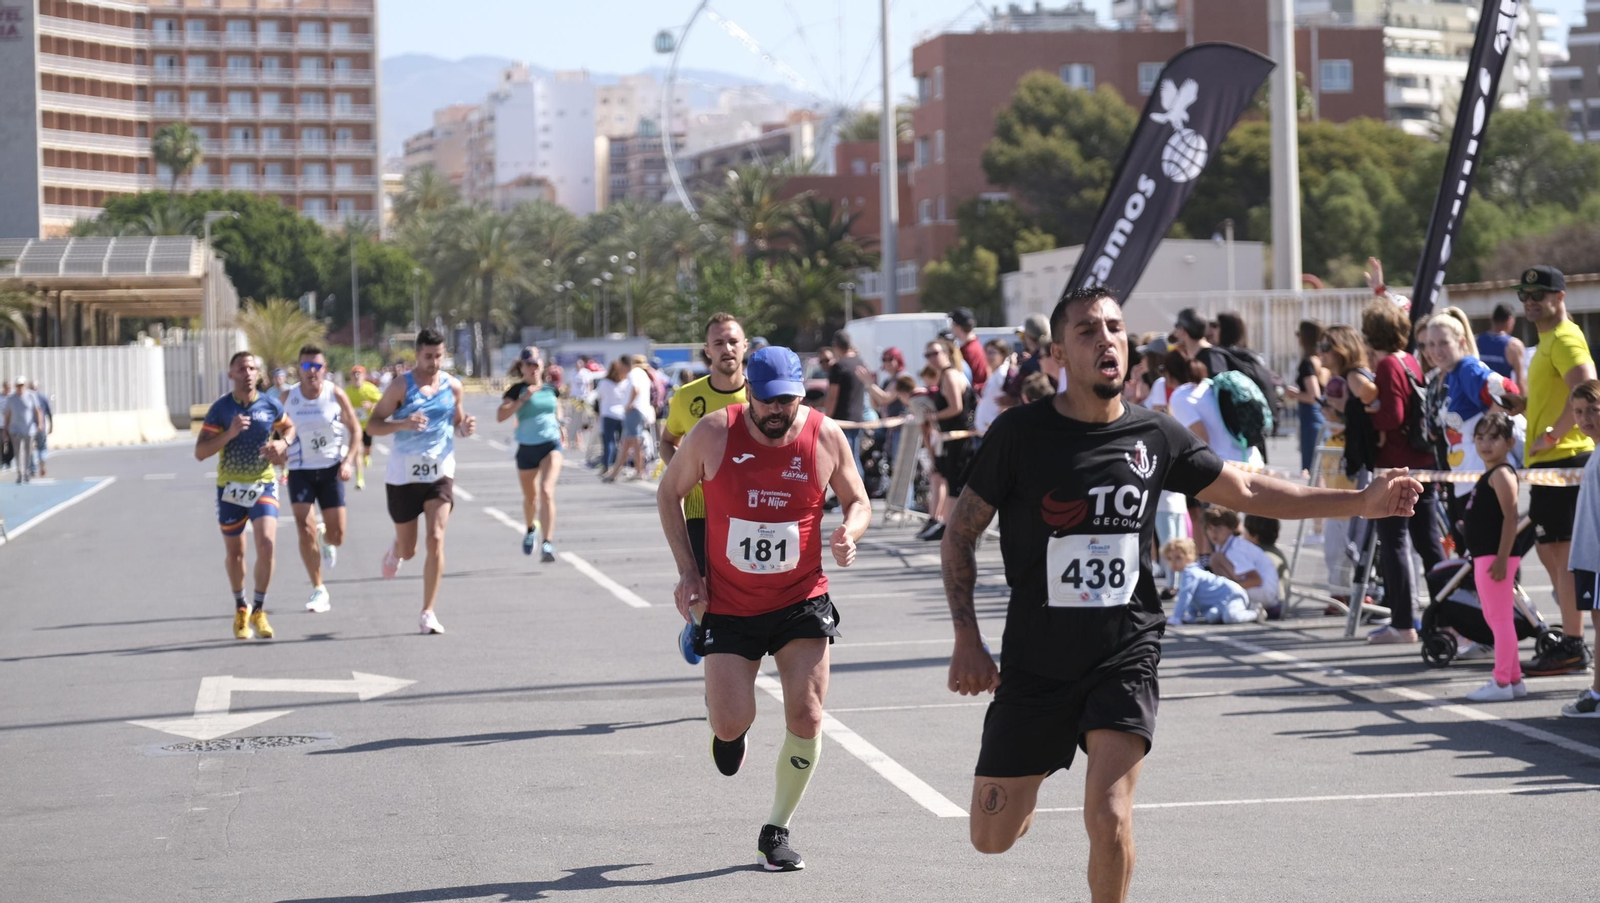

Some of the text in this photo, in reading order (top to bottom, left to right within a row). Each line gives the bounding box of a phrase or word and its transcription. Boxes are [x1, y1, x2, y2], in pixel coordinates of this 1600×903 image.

[310, 436, 327, 450] 36
[412, 463, 438, 476] 291
[230, 488, 257, 499] 179
[760, 489, 791, 498] Ayuntamiento
[1088, 484, 1149, 519] TCI
[739, 537, 787, 562] 181
[1061, 557, 1125, 589] 438
